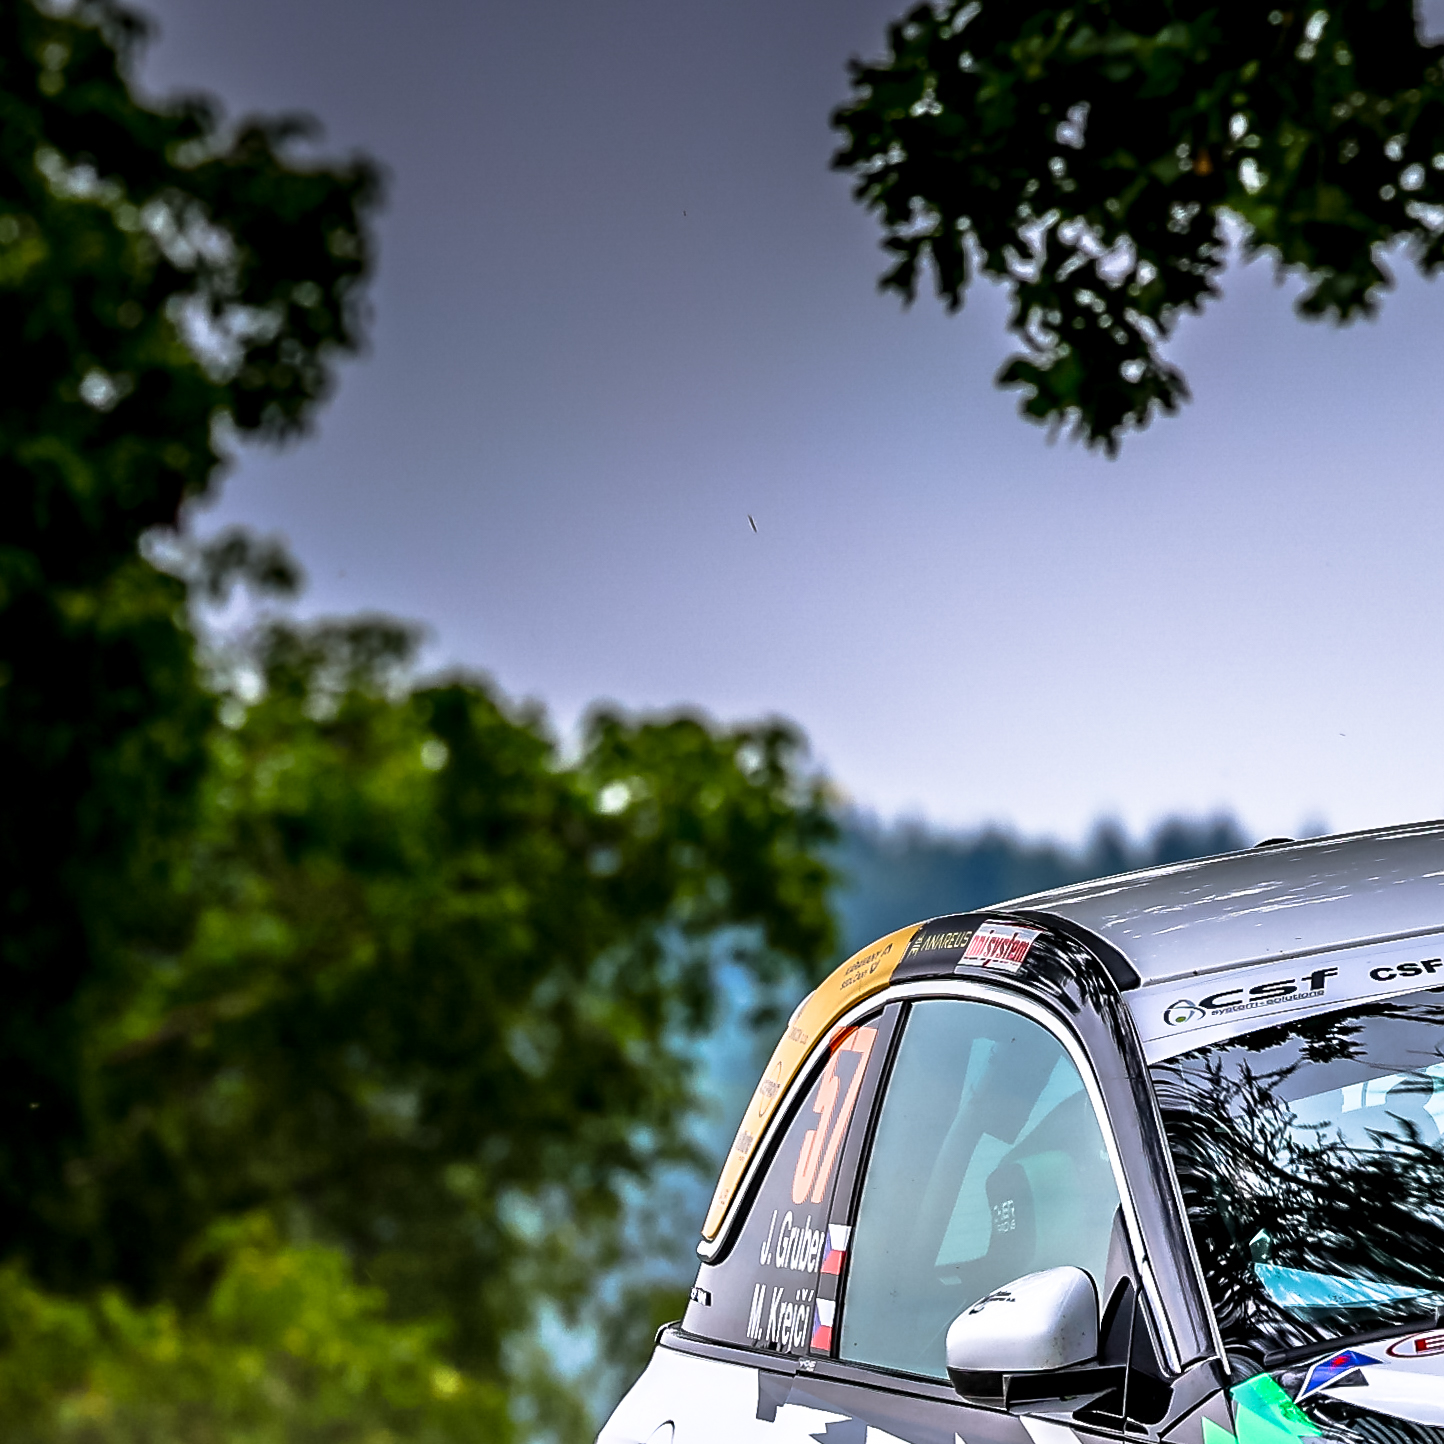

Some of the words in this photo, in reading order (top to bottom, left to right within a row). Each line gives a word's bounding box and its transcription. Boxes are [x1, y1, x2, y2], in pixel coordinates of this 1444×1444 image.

[1199, 966, 1338, 1009] csf
[1369, 958, 1443, 982] CSF
[792, 1026, 878, 1204] 57
[760, 1210, 777, 1265] J.
[776, 1210, 825, 1272] Gruber
[746, 1283, 766, 1340] M.
[766, 1286, 814, 1353] Krejčí
